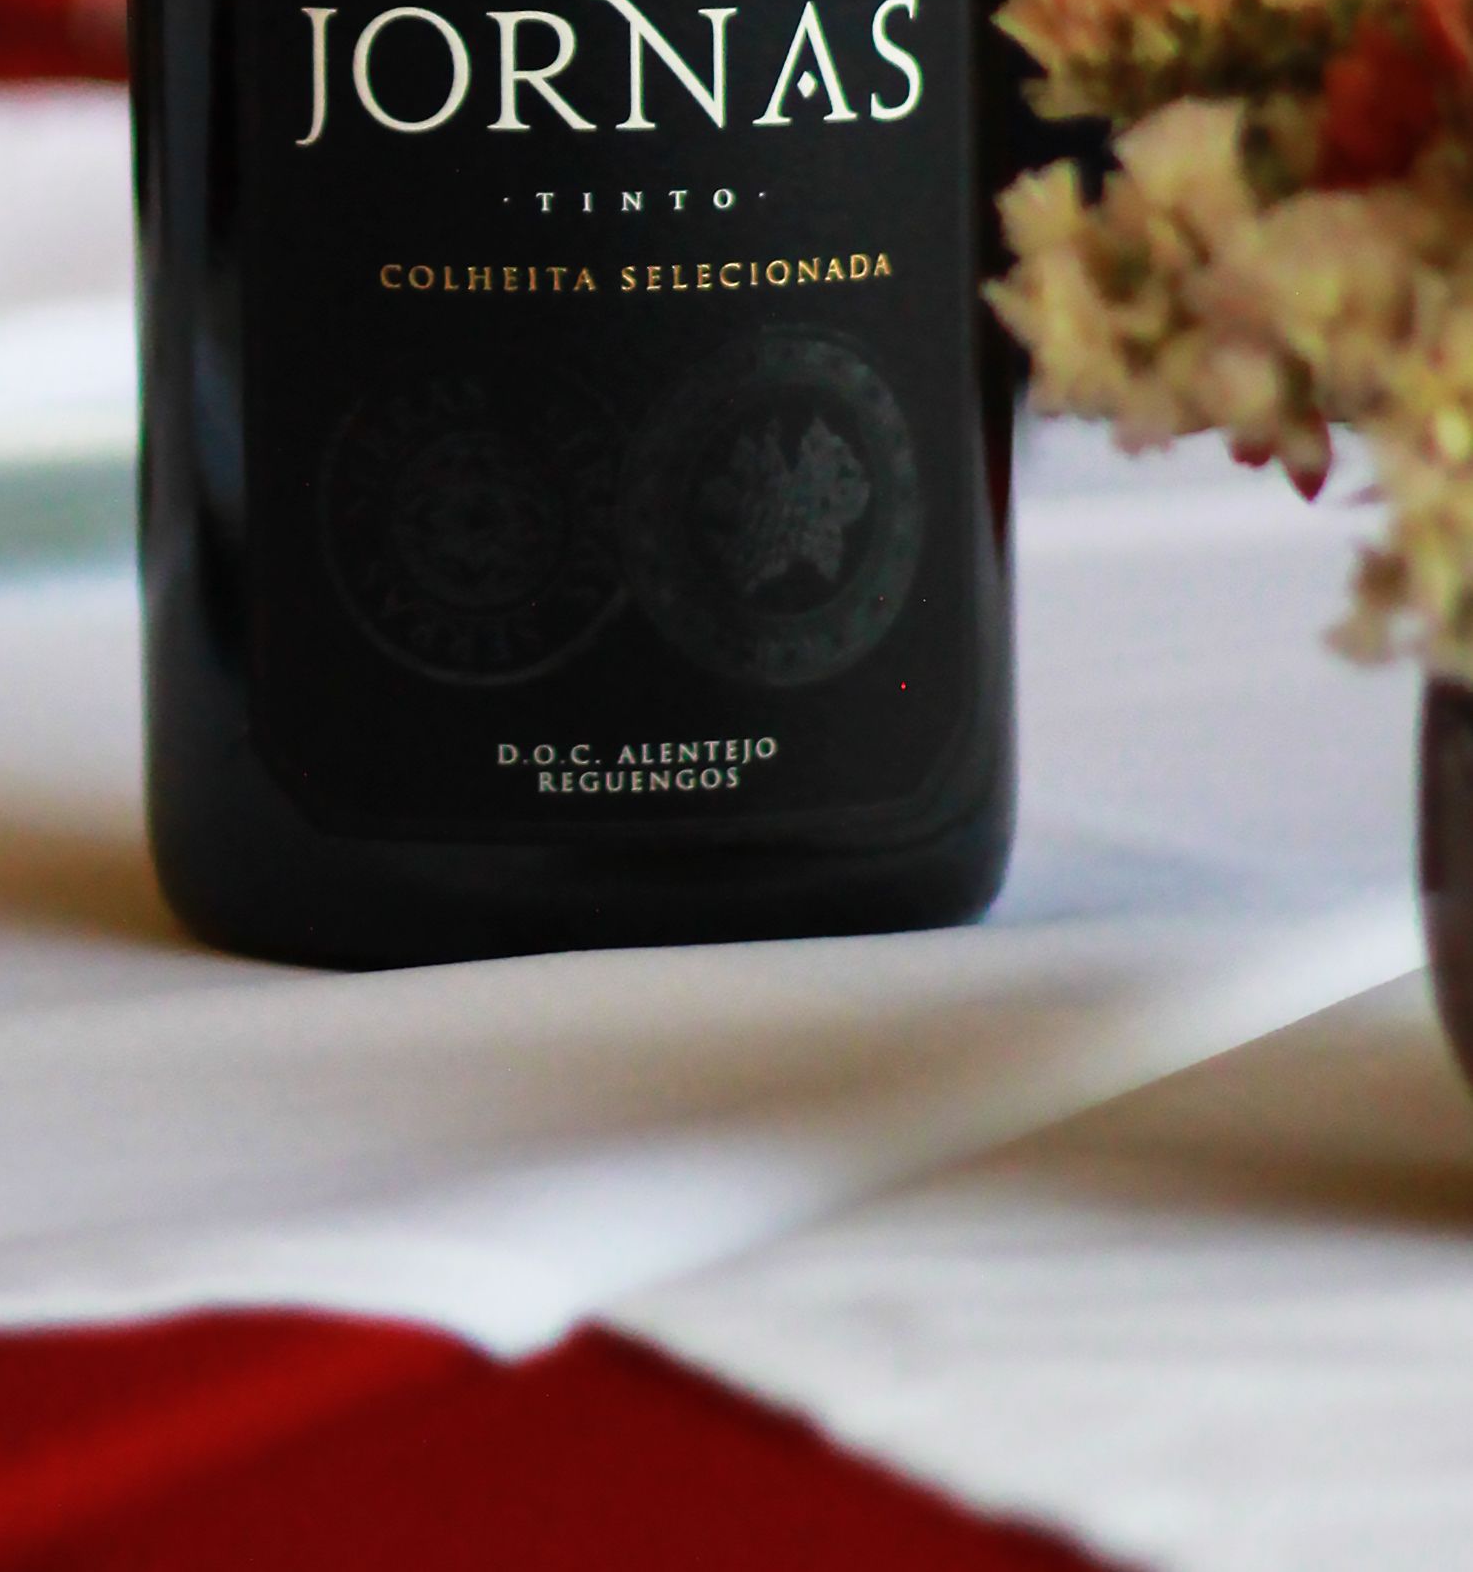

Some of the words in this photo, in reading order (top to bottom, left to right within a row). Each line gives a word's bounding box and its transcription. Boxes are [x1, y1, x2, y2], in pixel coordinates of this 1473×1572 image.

[535, 188, 737, 213] TINTO
[380, 263, 597, 292] COLHEITA
[620, 252, 893, 292] SELECIONADA
[498, 743, 602, 766] D.O.C.
[617, 736, 779, 765] ALENTEJO
[538, 766, 741, 793] REGUENGOS
